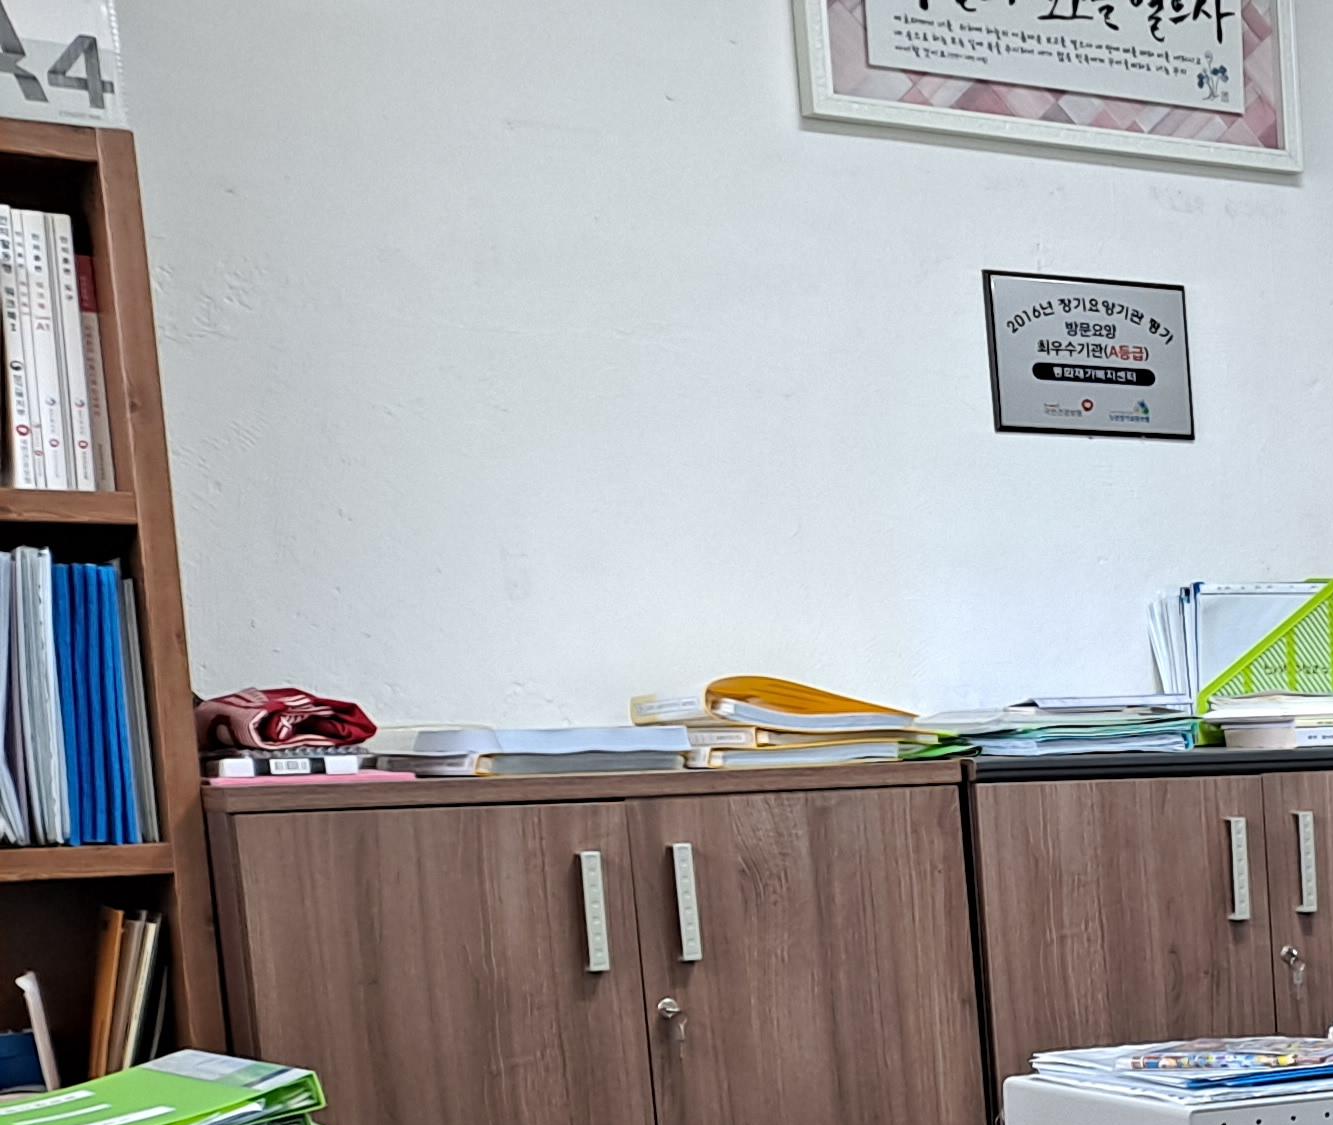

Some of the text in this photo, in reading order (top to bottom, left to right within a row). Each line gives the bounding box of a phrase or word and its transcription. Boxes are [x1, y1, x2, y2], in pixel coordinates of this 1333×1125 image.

[1006, 298, 1174, 345] 2016년 장기요양기관 평가
[1065, 321, 1117, 339] 방문요양
[1037, 339, 1150, 361] 최우수기관(A등급)
